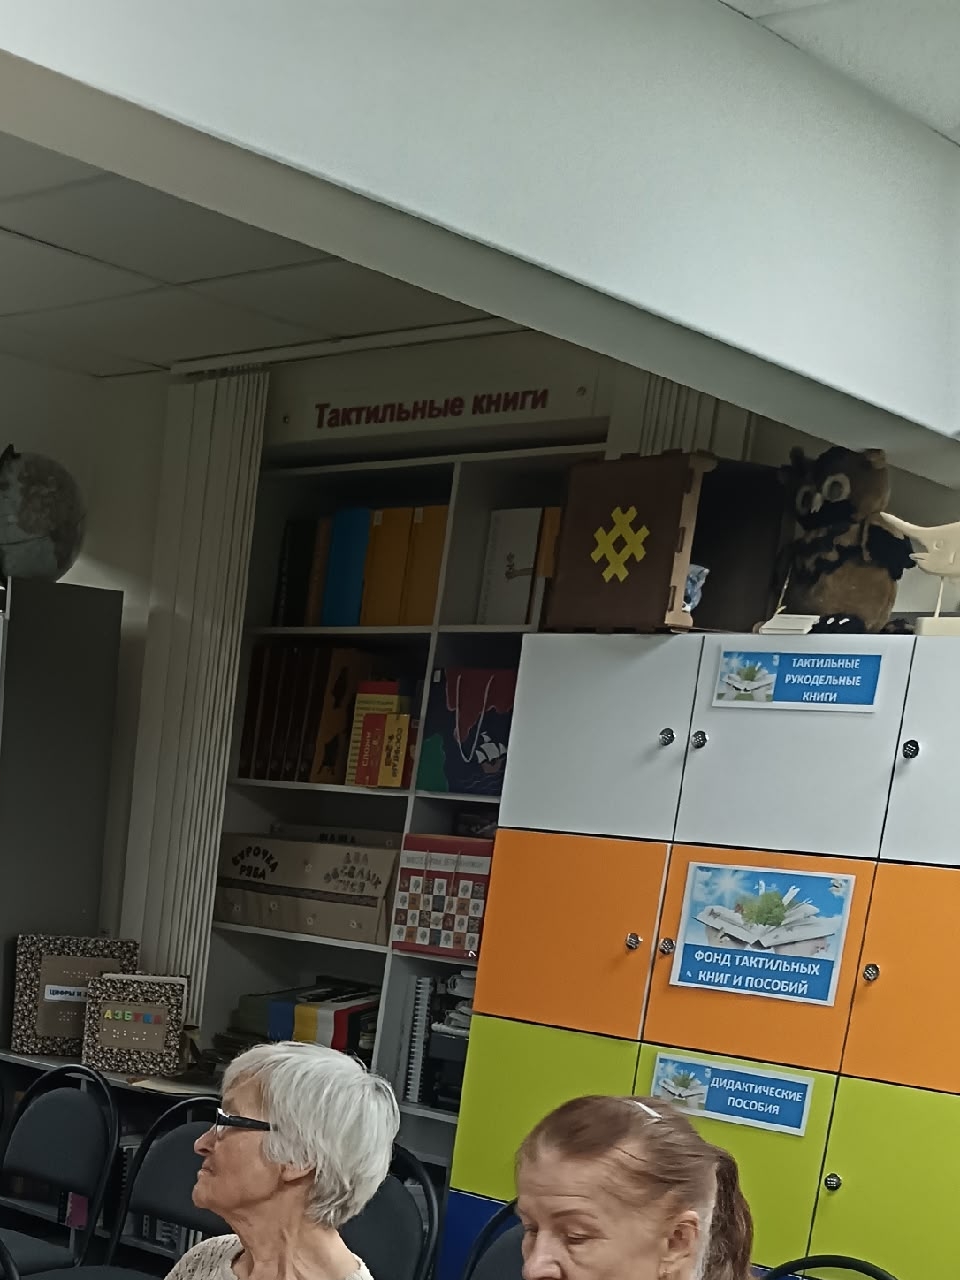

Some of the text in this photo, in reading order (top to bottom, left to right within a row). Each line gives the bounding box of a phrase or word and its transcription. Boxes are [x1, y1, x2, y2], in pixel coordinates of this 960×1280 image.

[314, 388, 549, 429] Тактильные книги
[792, 658, 860, 669] ТАКТИЛЬНЫЕ
[784, 674, 862, 686] РУКОДЕЛЬНЫЕ
[802, 691, 838, 702] КНИГИ
[694, 950, 820, 976] ФОНД ТАКТИЛЬНЫХ
[697, 970, 808, 995] КНИГ И ПОСОБИЙ
[710, 1077, 804, 1102] ДИДАКТИЧЕСКИЕ
[727, 1096, 780, 1115] ПОСОБИЯ
